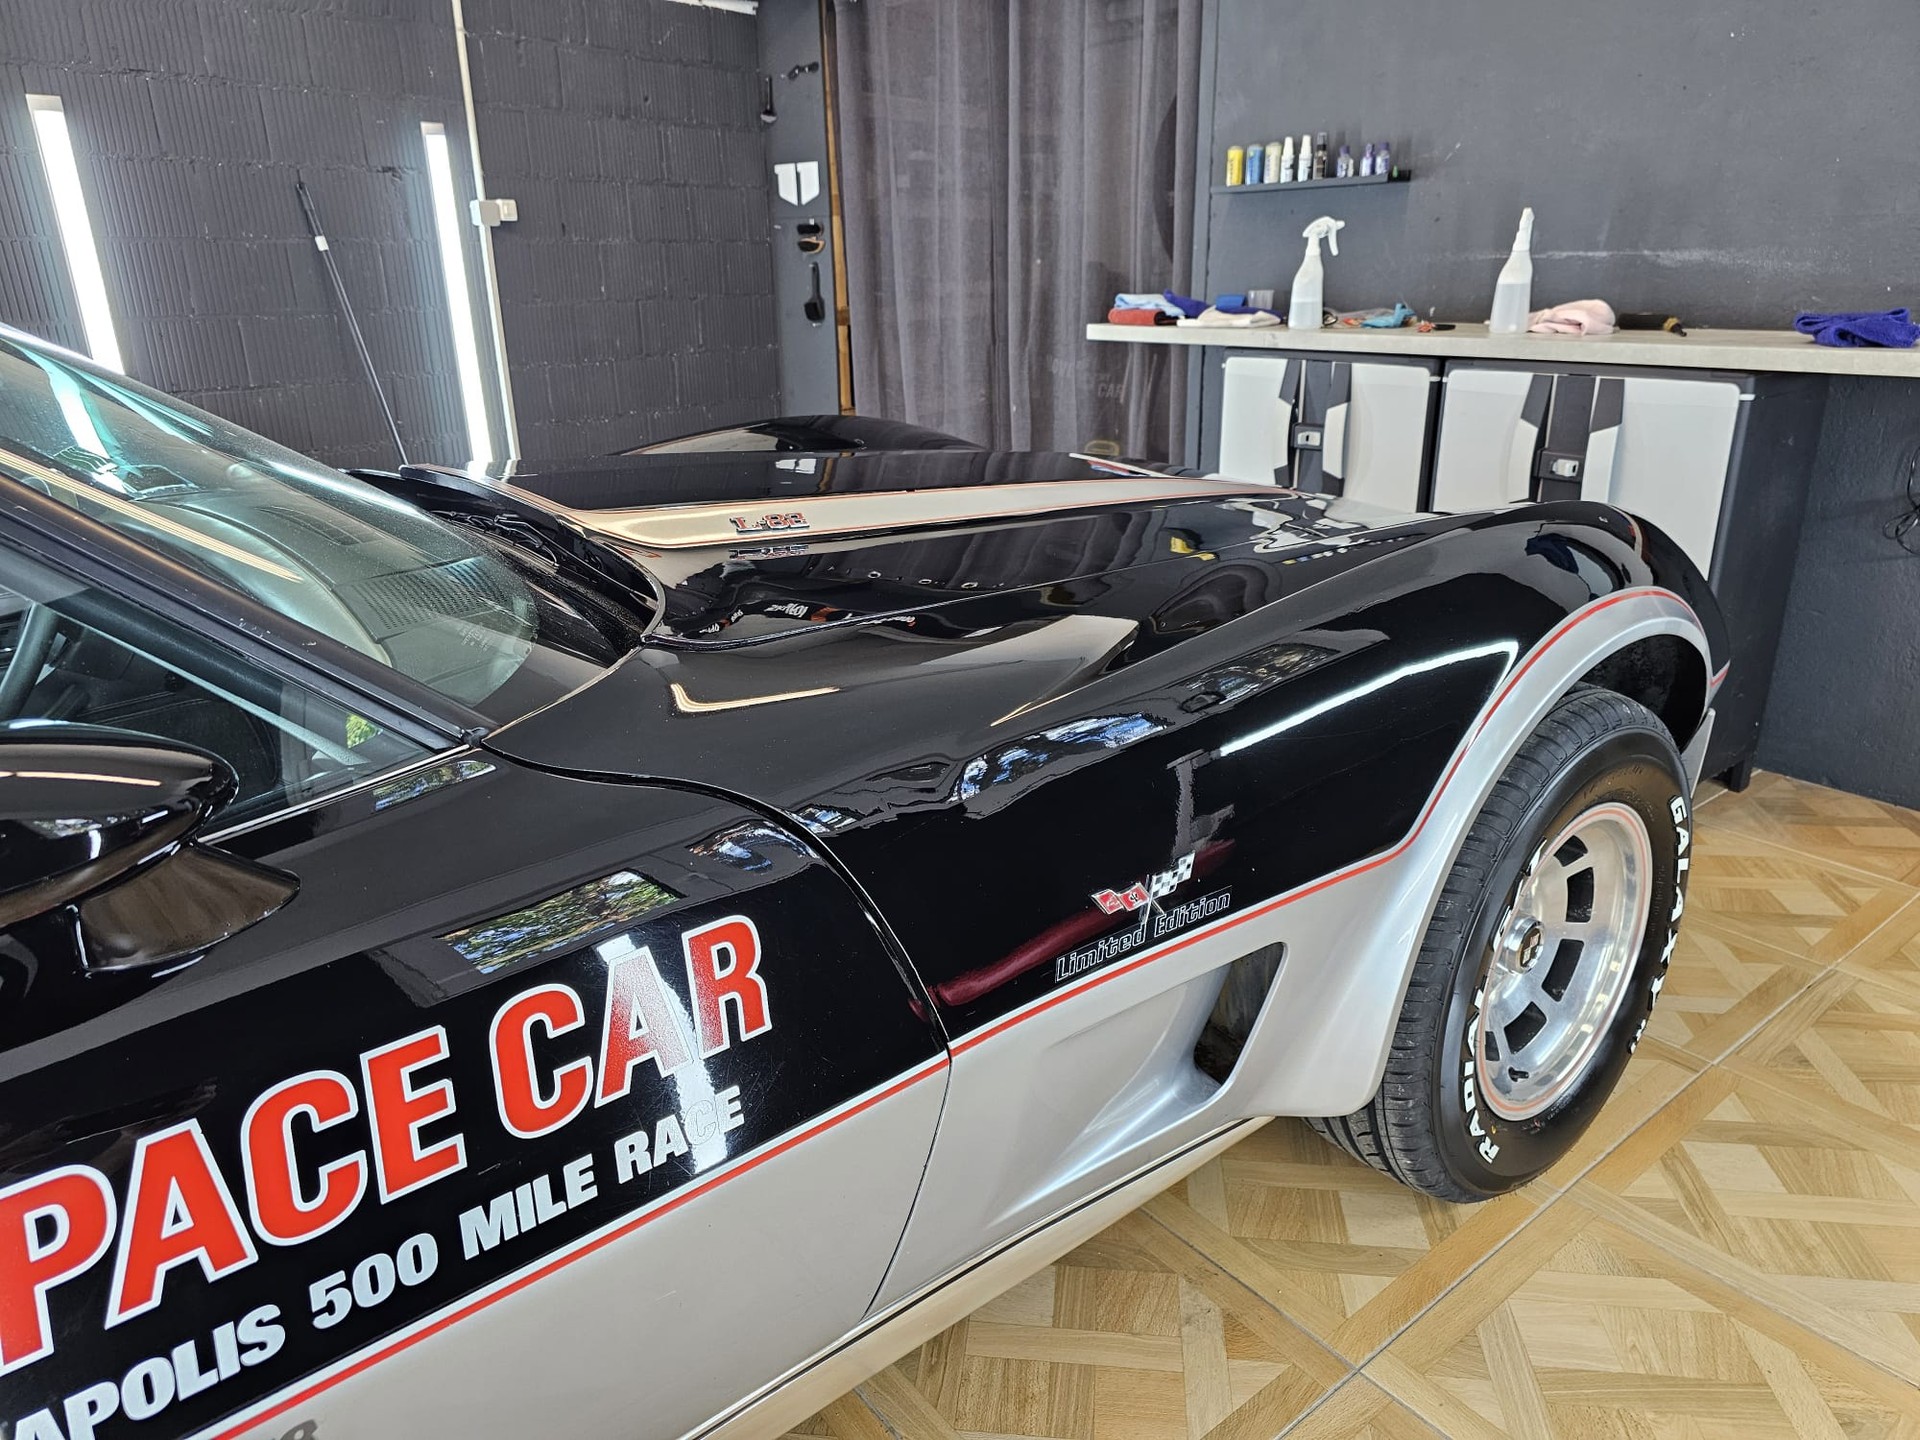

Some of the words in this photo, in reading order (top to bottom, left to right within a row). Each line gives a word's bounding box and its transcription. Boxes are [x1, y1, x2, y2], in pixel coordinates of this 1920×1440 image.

[1055, 924, 1147, 983] Limited
[1154, 892, 1231, 938] Edition
[1651, 796, 1690, 1010] GALAXY
[0, 1025, 467, 1376] PACE
[489, 914, 773, 1139] CAR
[309, 1232, 439, 1330] 500
[459, 1155, 599, 1260] MILE
[614, 1085, 746, 1184] RACE
